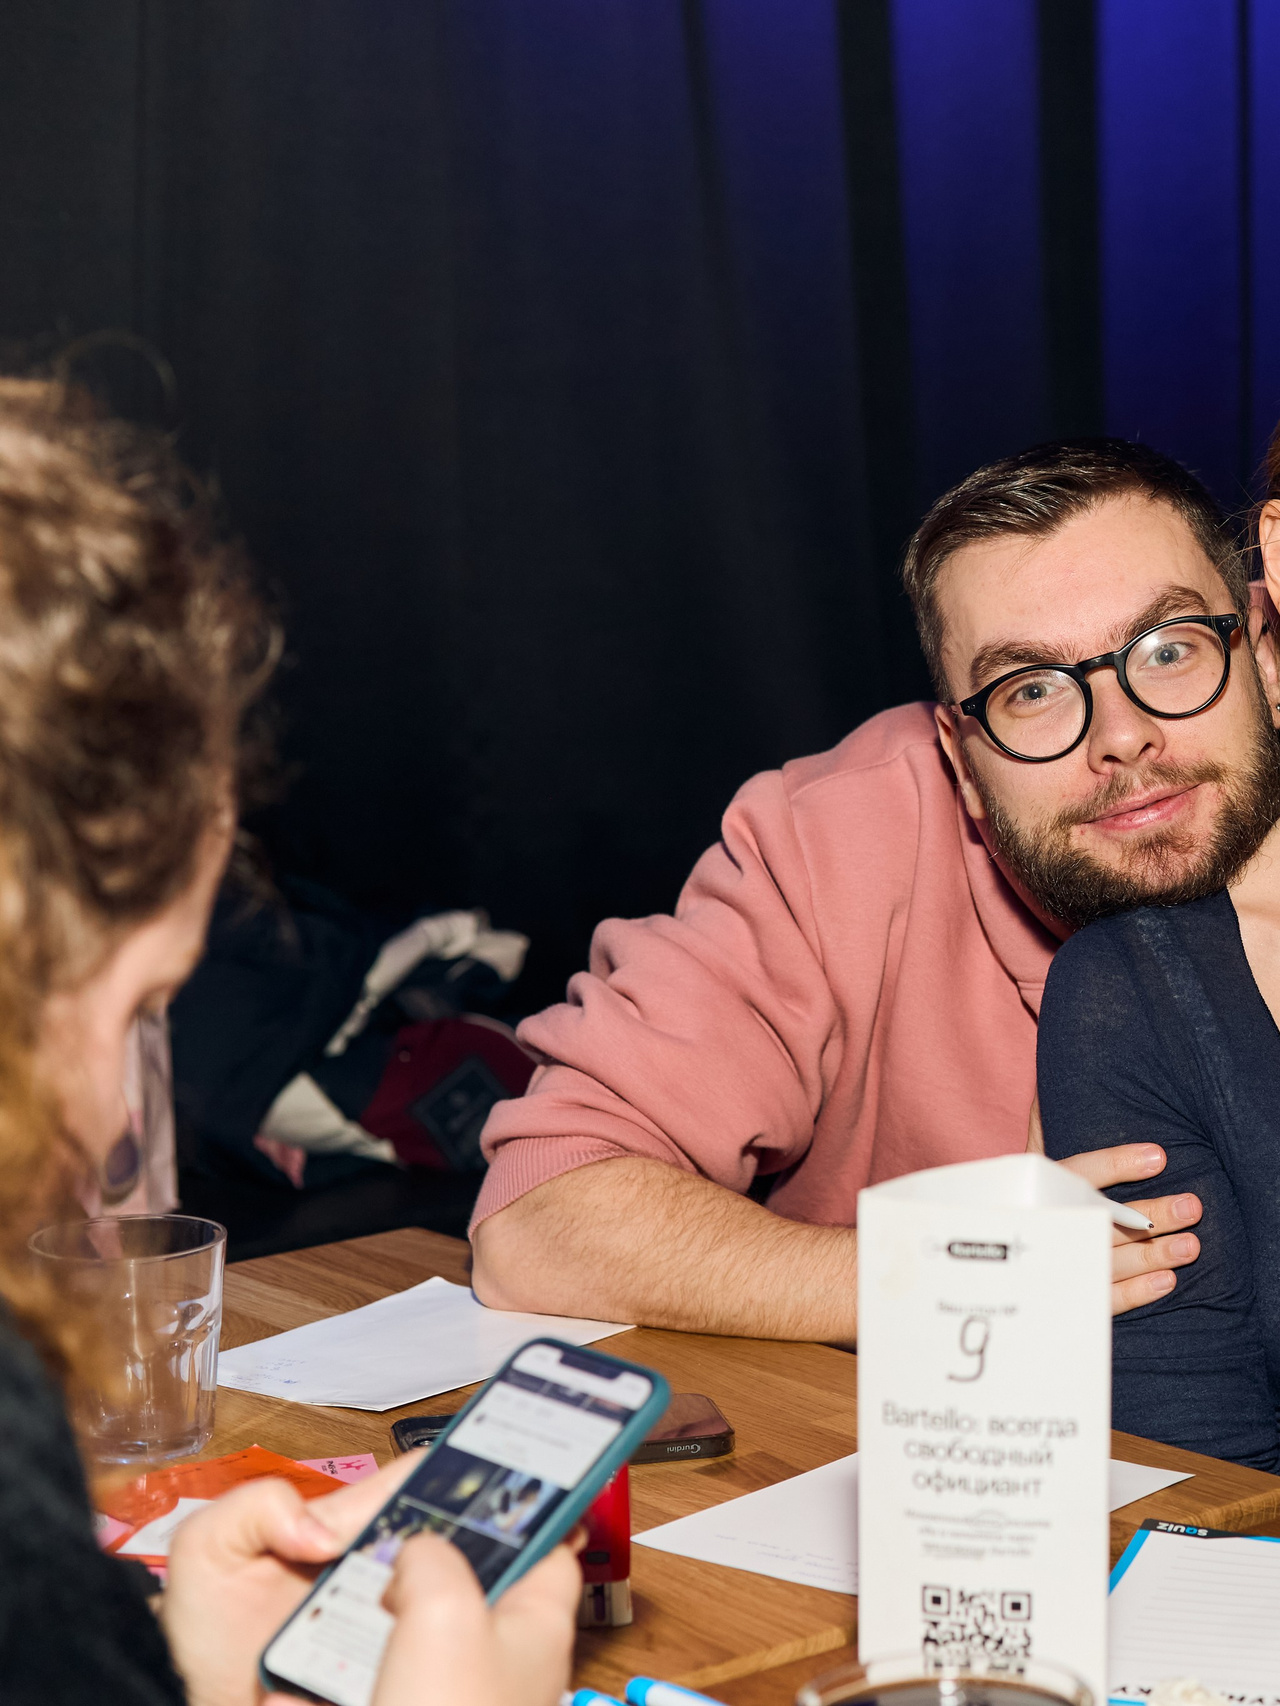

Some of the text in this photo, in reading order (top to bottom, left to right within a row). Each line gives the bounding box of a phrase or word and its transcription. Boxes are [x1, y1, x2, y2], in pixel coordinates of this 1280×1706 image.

[987, 1415, 1079, 1440] всегда
[666, 1443, 701, 1455] Gurdini
[903, 1434, 1055, 1468] свободный
[911, 1467, 1043, 1497] официант
